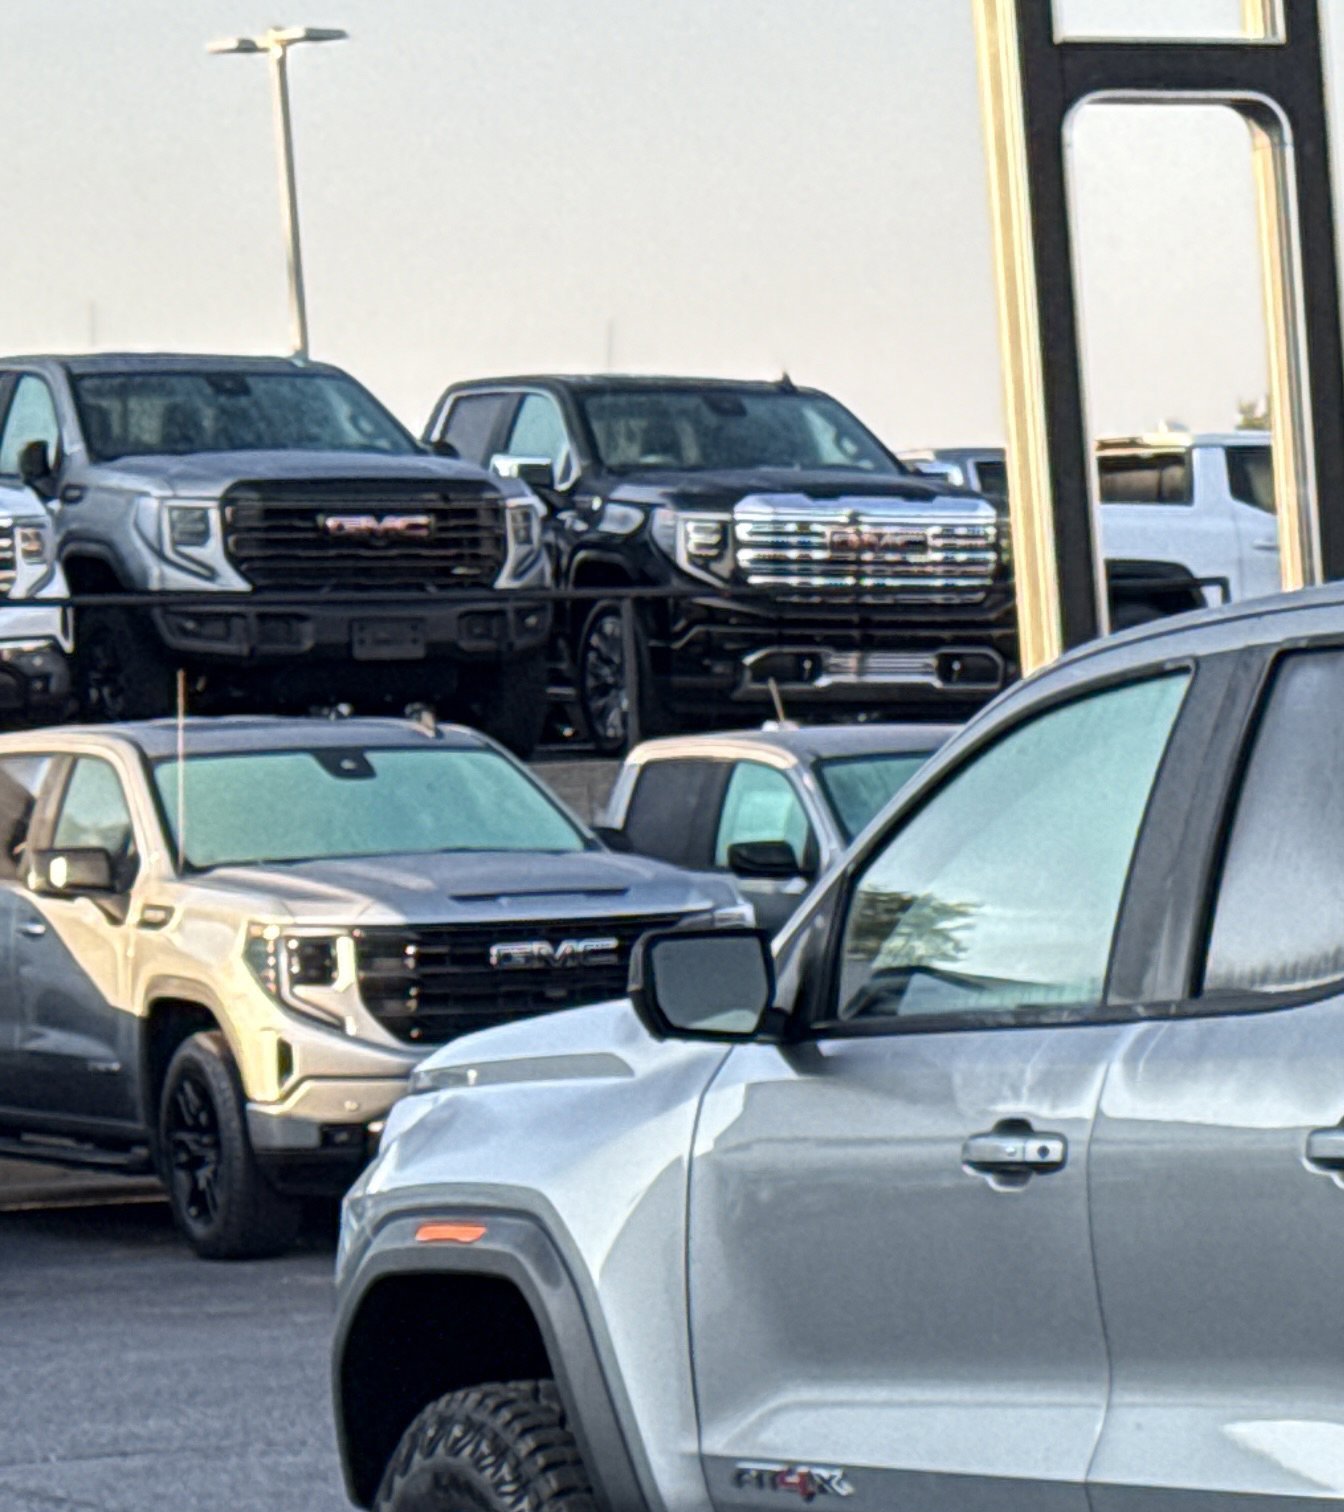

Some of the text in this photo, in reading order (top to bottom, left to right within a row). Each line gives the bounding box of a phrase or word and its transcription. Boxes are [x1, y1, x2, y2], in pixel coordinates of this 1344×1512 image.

[325, 514, 432, 537] GMC
[488, 937, 618, 969] GMC
[732, 1460, 854, 1502] AT4X
